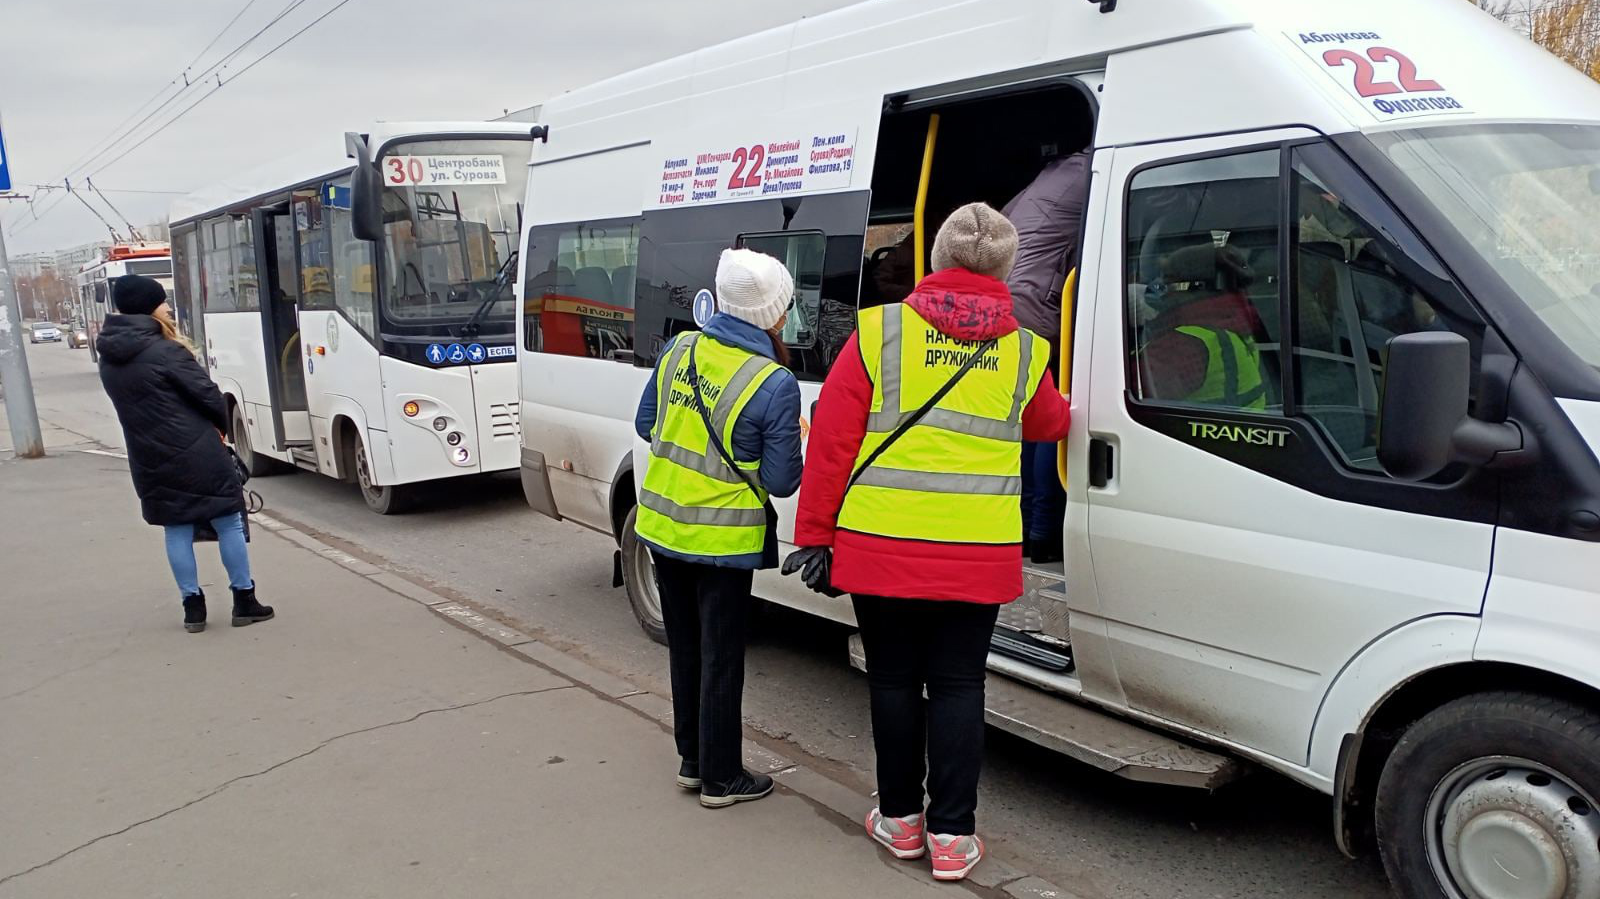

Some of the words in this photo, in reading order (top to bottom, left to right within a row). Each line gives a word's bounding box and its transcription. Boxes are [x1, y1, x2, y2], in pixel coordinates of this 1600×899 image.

[1298, 31, 1382, 44] Аблукова
[1322, 46, 1446, 98] 22
[1372, 95, 1464, 114] Филатова
[428, 157, 500, 169] Центробанк
[664, 158, 688, 170] Аблукова
[728, 144, 765, 190] 22
[766, 155, 798, 168] Димитрова
[388, 158, 424, 184] 30
[431, 172, 450, 183] ул.
[454, 170, 498, 182] Сурова
[491, 347, 513, 355] ЕСПБ
[1187, 421, 1291, 447] TRANSIT
